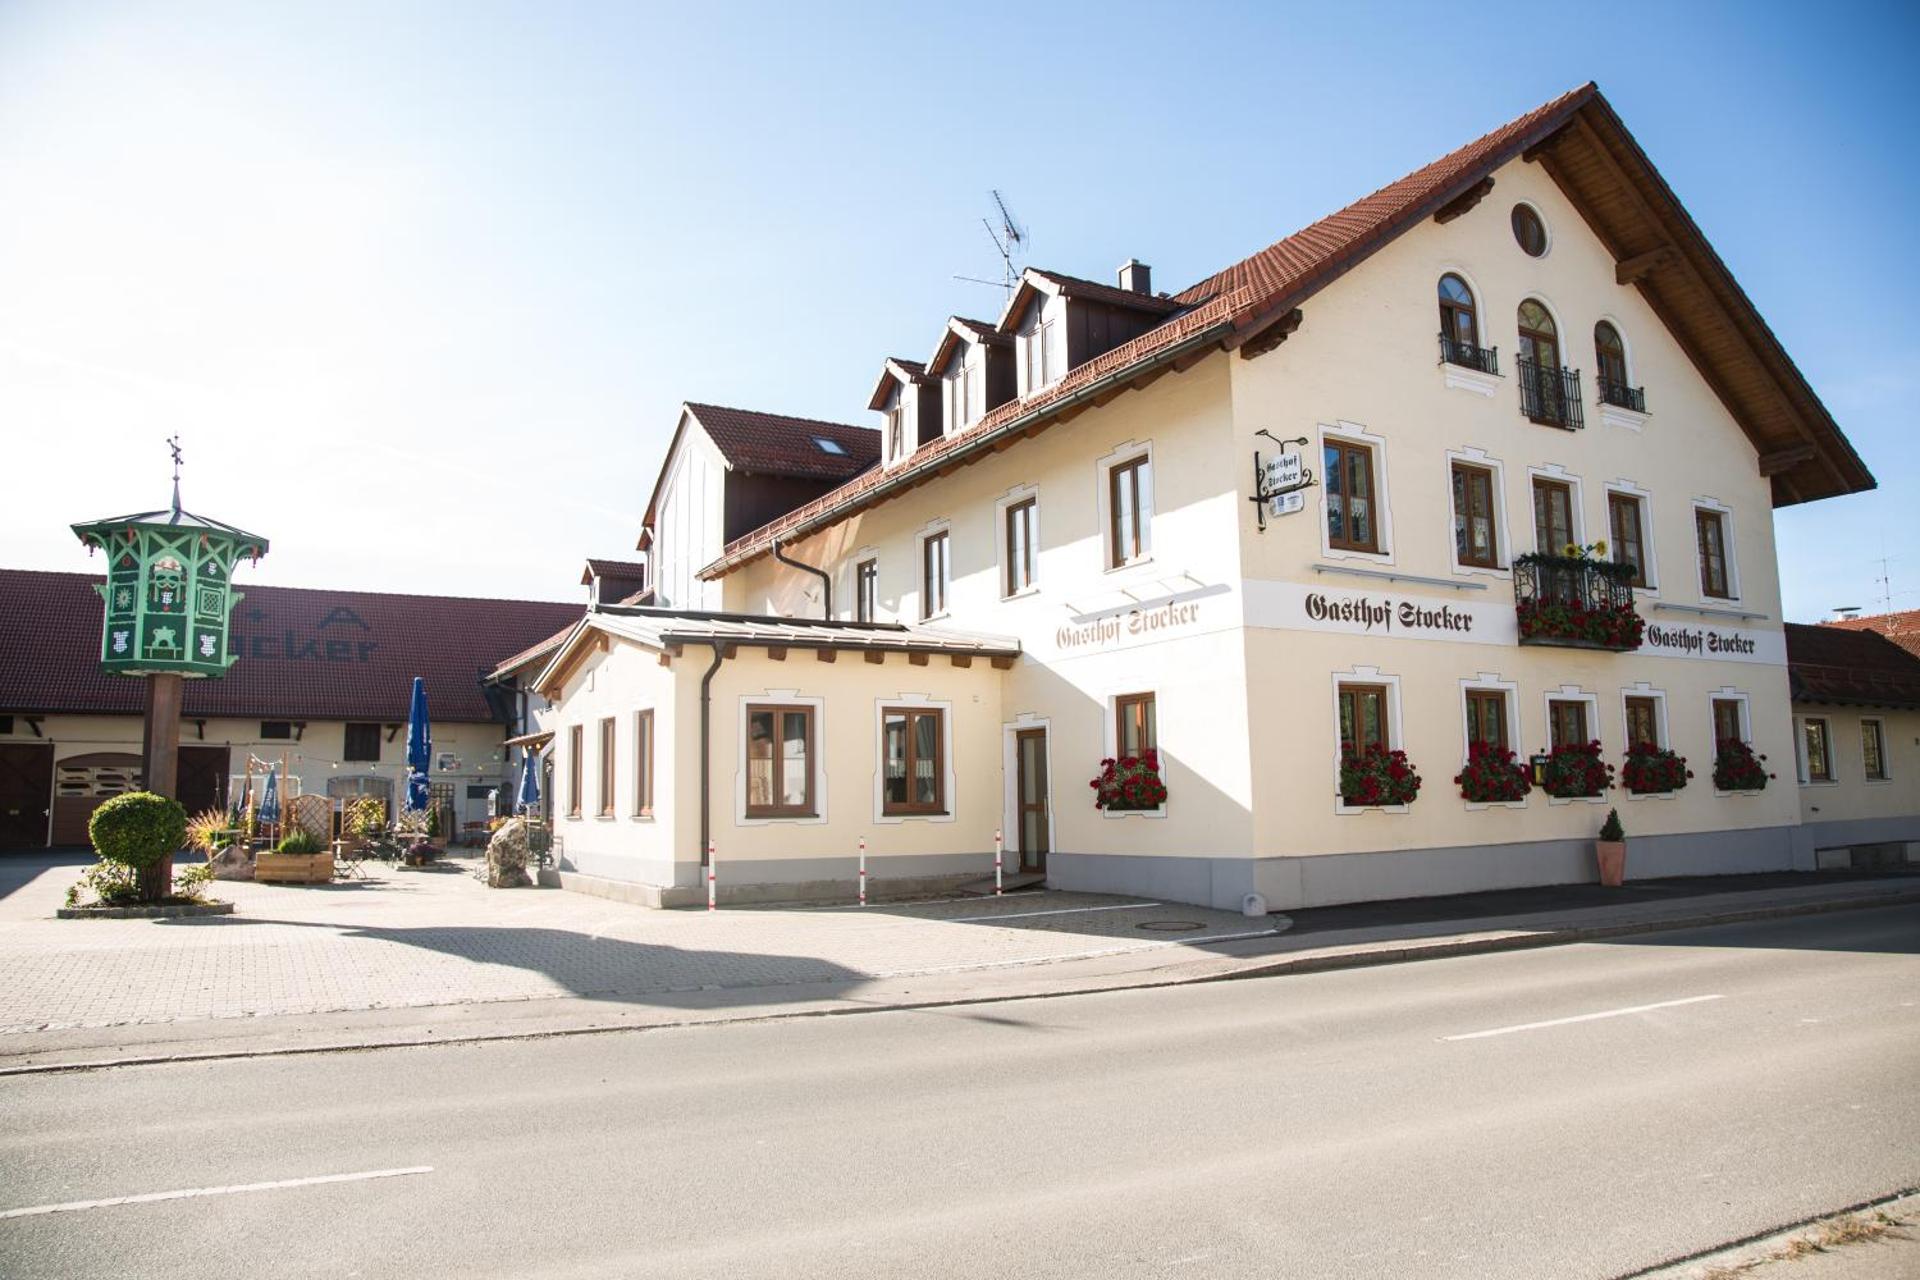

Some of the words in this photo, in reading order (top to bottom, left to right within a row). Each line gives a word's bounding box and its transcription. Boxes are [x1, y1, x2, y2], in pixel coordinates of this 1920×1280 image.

[1055, 614, 1121, 649] Gasthof
[1128, 600, 1200, 635] Stocker
[1305, 593, 1392, 633] Gasthof
[1398, 602, 1473, 632] Stocker
[1648, 624, 1703, 655] Gasthof
[1707, 631, 1756, 655] Stocker
